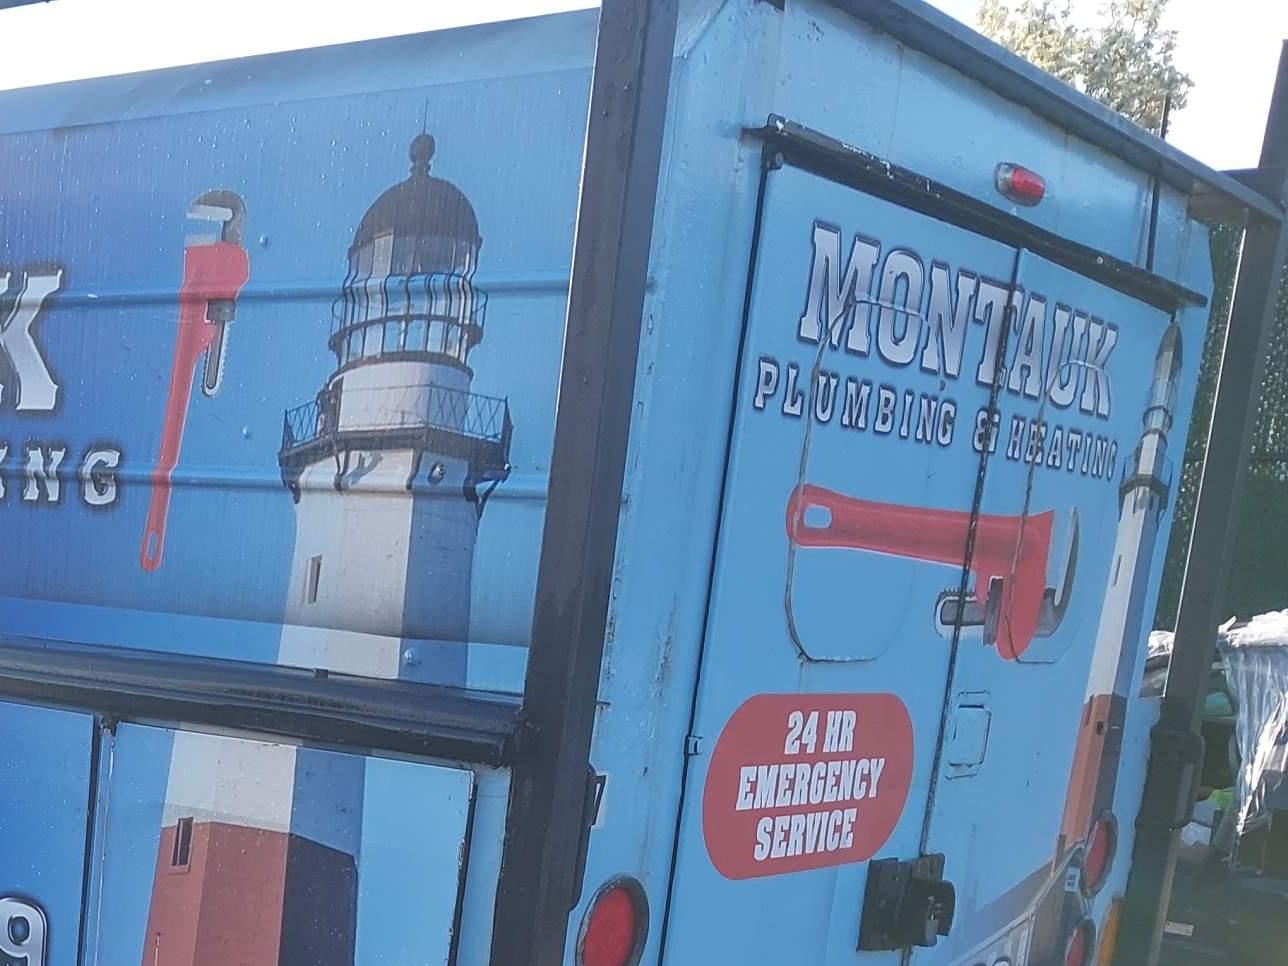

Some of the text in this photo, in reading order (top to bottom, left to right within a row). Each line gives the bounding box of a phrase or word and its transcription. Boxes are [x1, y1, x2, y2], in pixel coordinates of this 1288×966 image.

[797, 221, 1118, 418] MONTAUK
[753, 357, 958, 447] PLUMBING
[784, 711, 857, 754] 24 HR
[735, 757, 885, 811] EMERGENCY
[754, 808, 858, 861] SERVICE
